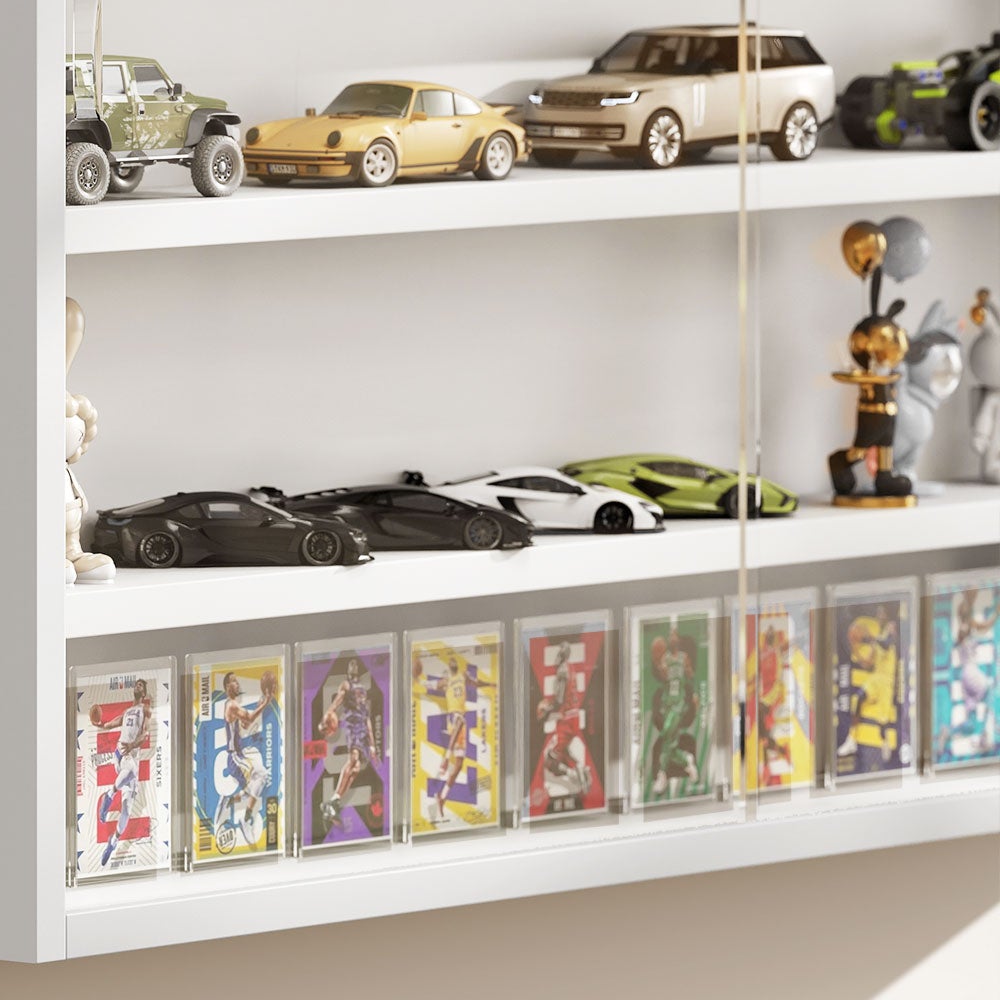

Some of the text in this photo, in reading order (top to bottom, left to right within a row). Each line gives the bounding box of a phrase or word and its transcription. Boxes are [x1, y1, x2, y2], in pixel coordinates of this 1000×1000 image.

[201, 675, 210, 695] MAIL
[201, 702, 210, 717] AIR
[155, 746, 163, 787] SIXERS
[265, 722, 274, 788] WARRIORS
